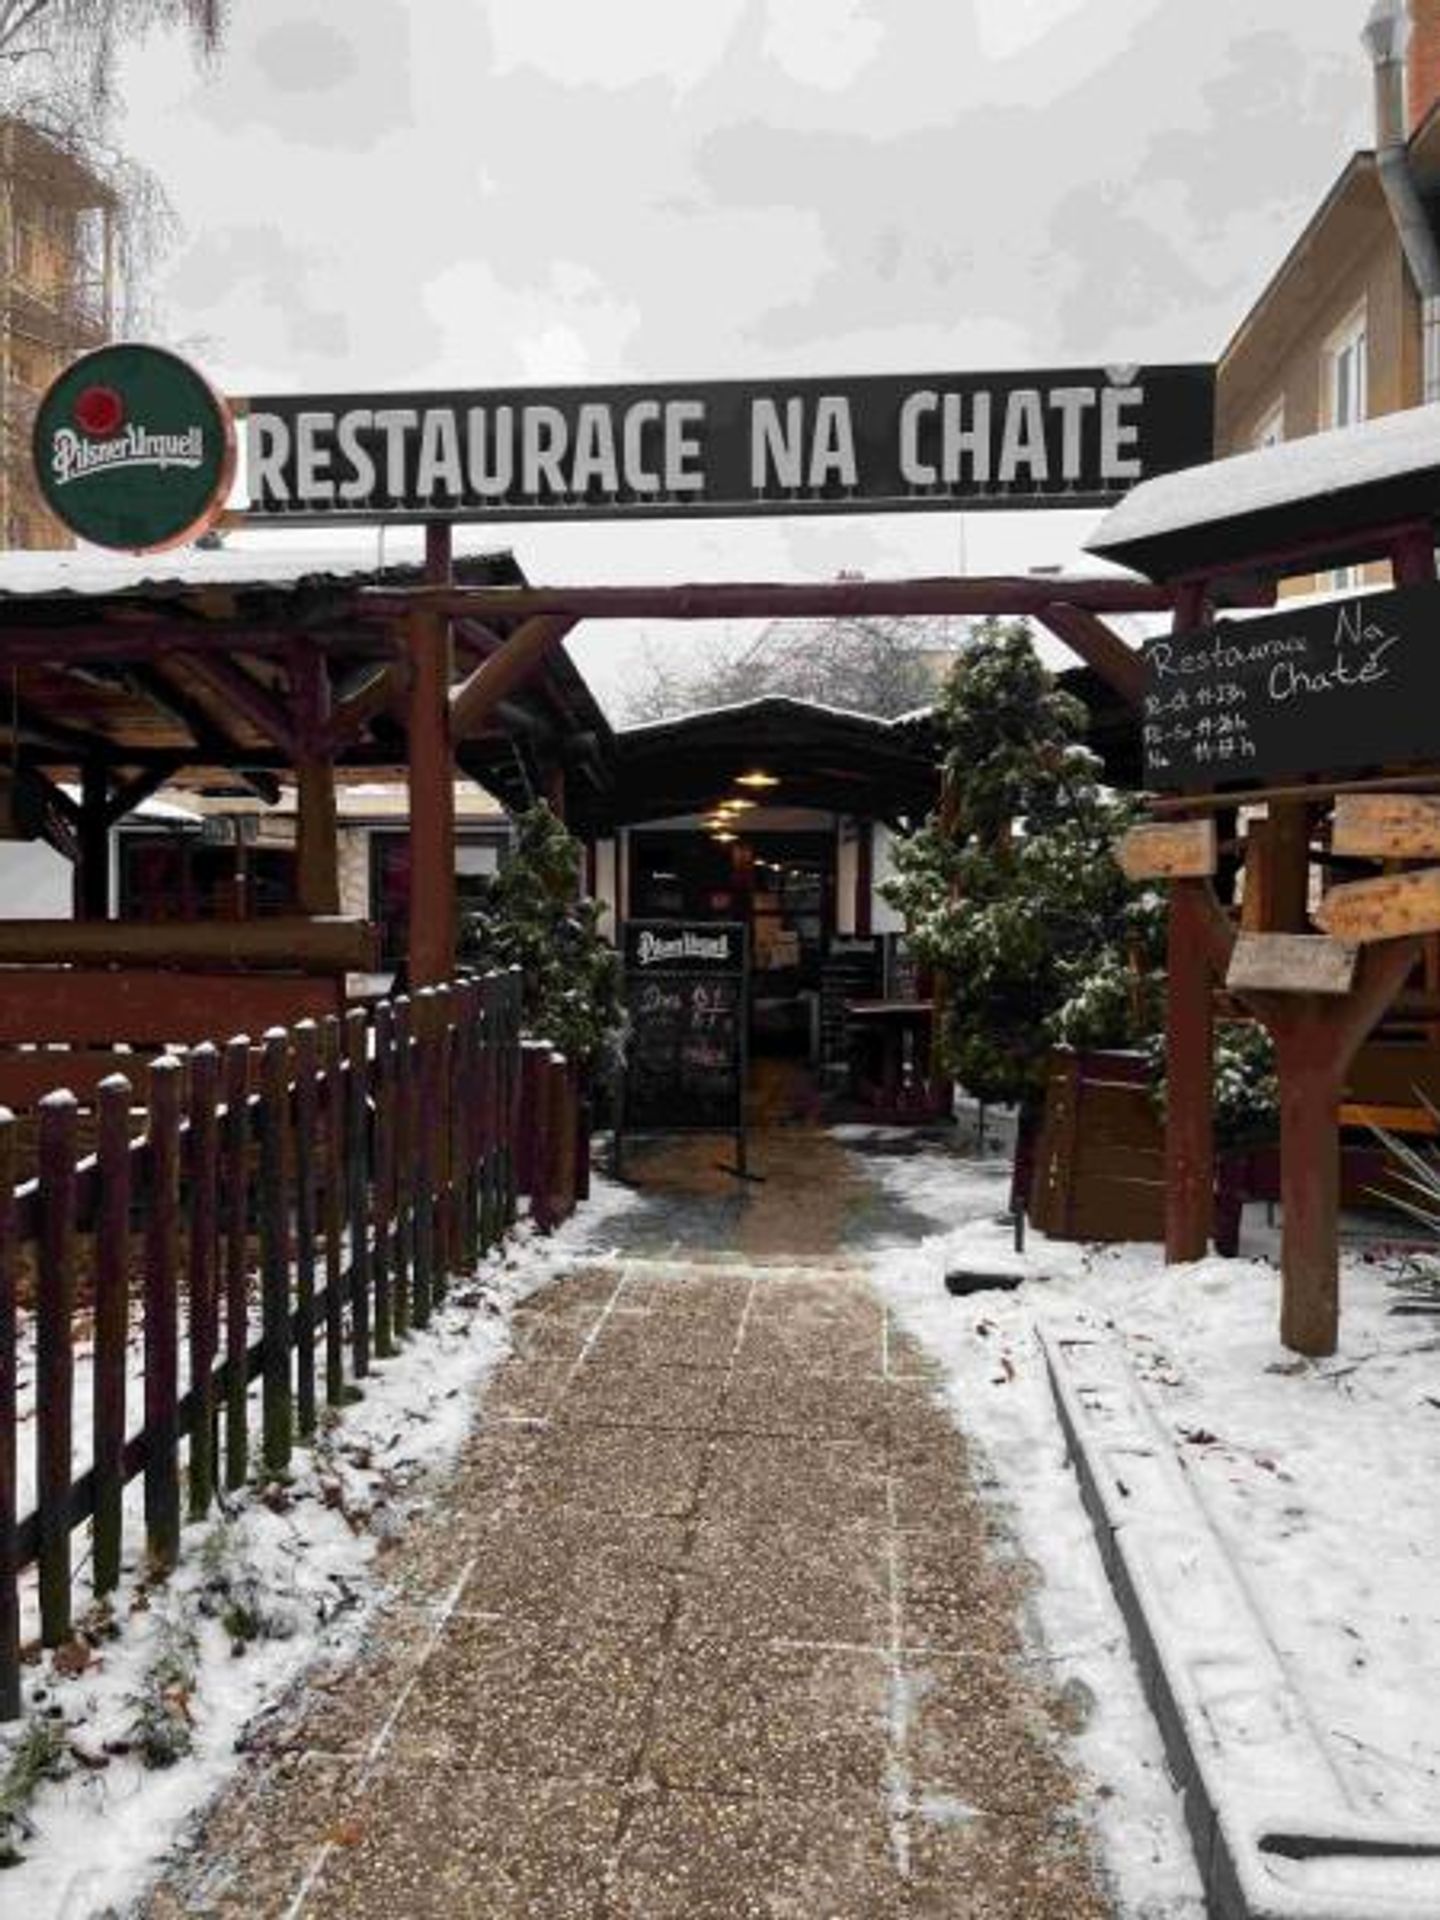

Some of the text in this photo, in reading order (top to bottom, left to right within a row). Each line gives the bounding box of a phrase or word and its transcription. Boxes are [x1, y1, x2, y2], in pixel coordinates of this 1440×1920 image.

[52, 422, 204, 484] Pilsner Urquell
[248, 366, 1144, 500] RESTAURACE NA CHATĚ
[1333, 600, 1385, 646] Na
